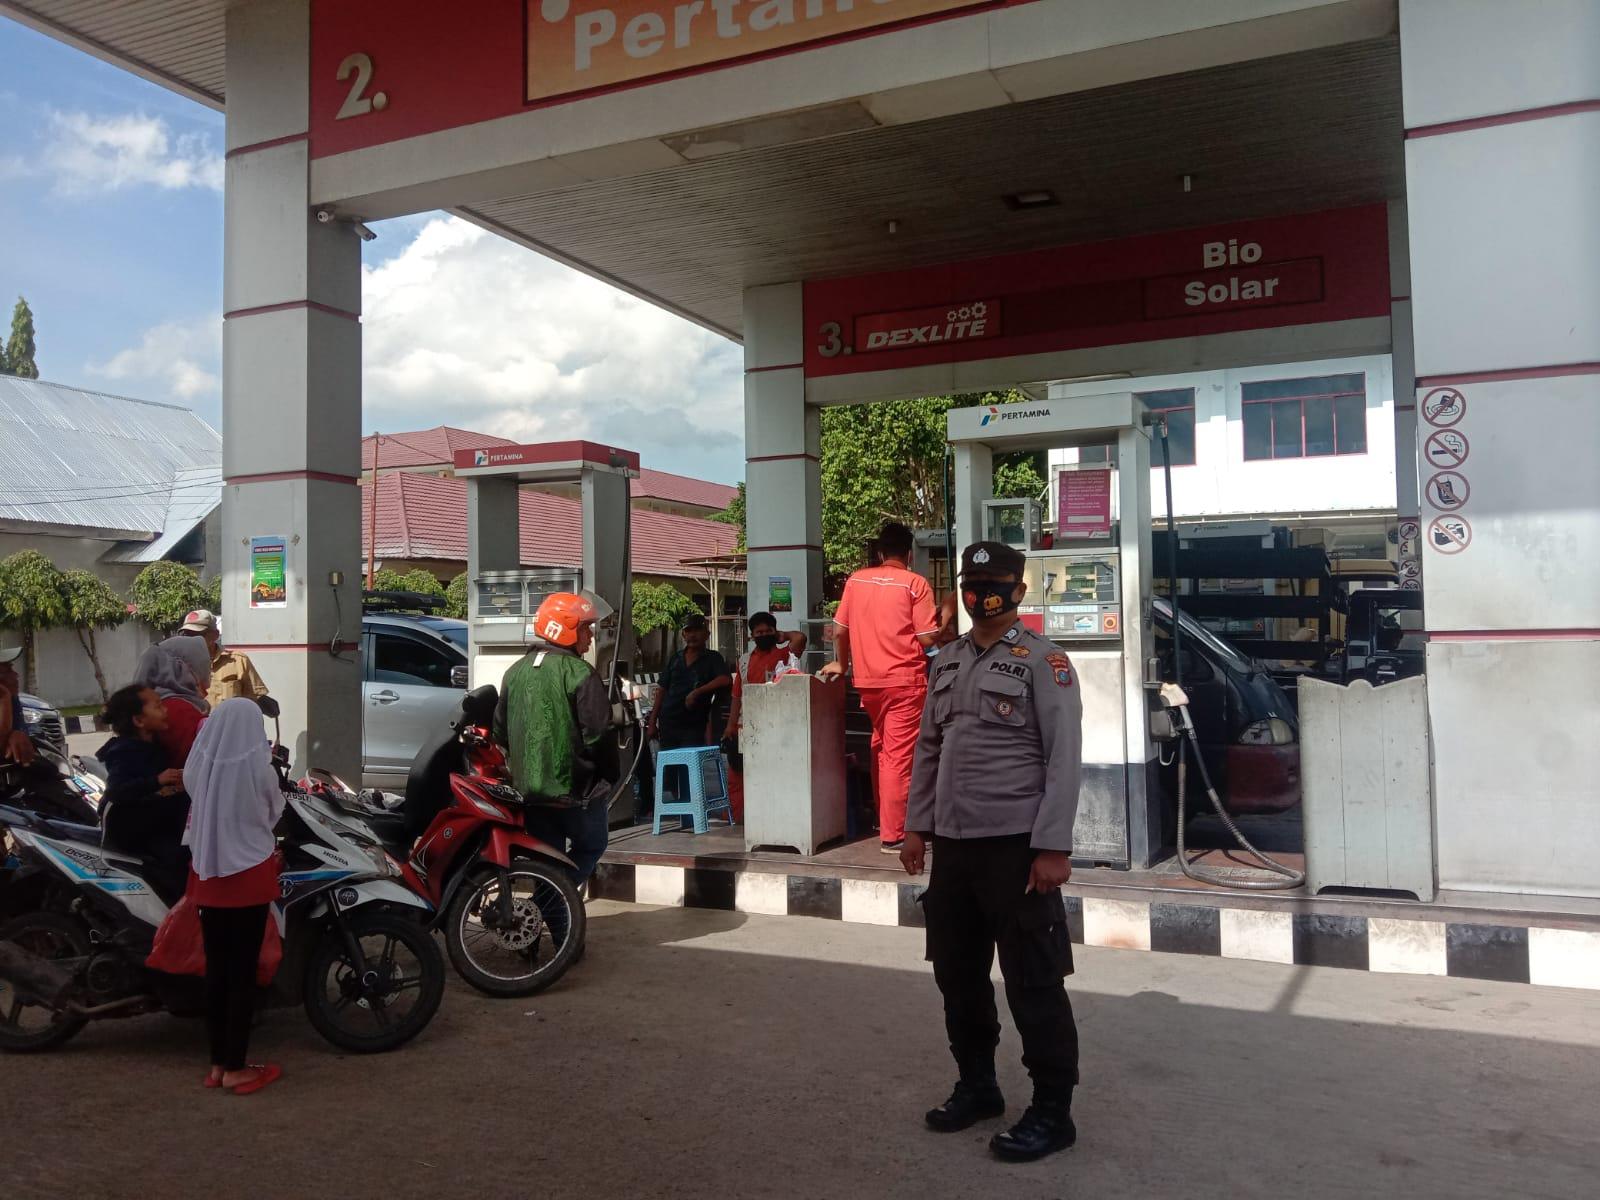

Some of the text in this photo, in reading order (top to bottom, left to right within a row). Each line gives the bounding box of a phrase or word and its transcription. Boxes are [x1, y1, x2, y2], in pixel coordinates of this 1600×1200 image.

[335, 53, 388, 120] 2.
[1203, 239, 1262, 268] Bio
[1184, 277, 1279, 306] Solar
[818, 322, 852, 357] 3.
[866, 319, 988, 349] DEXLITE
[1001, 408, 1051, 420] PERTAMINA
[490, 452, 524, 462] PERTAMINA
[989, 661, 1026, 678] POLRI
[322, 850, 349, 867] HONDA
